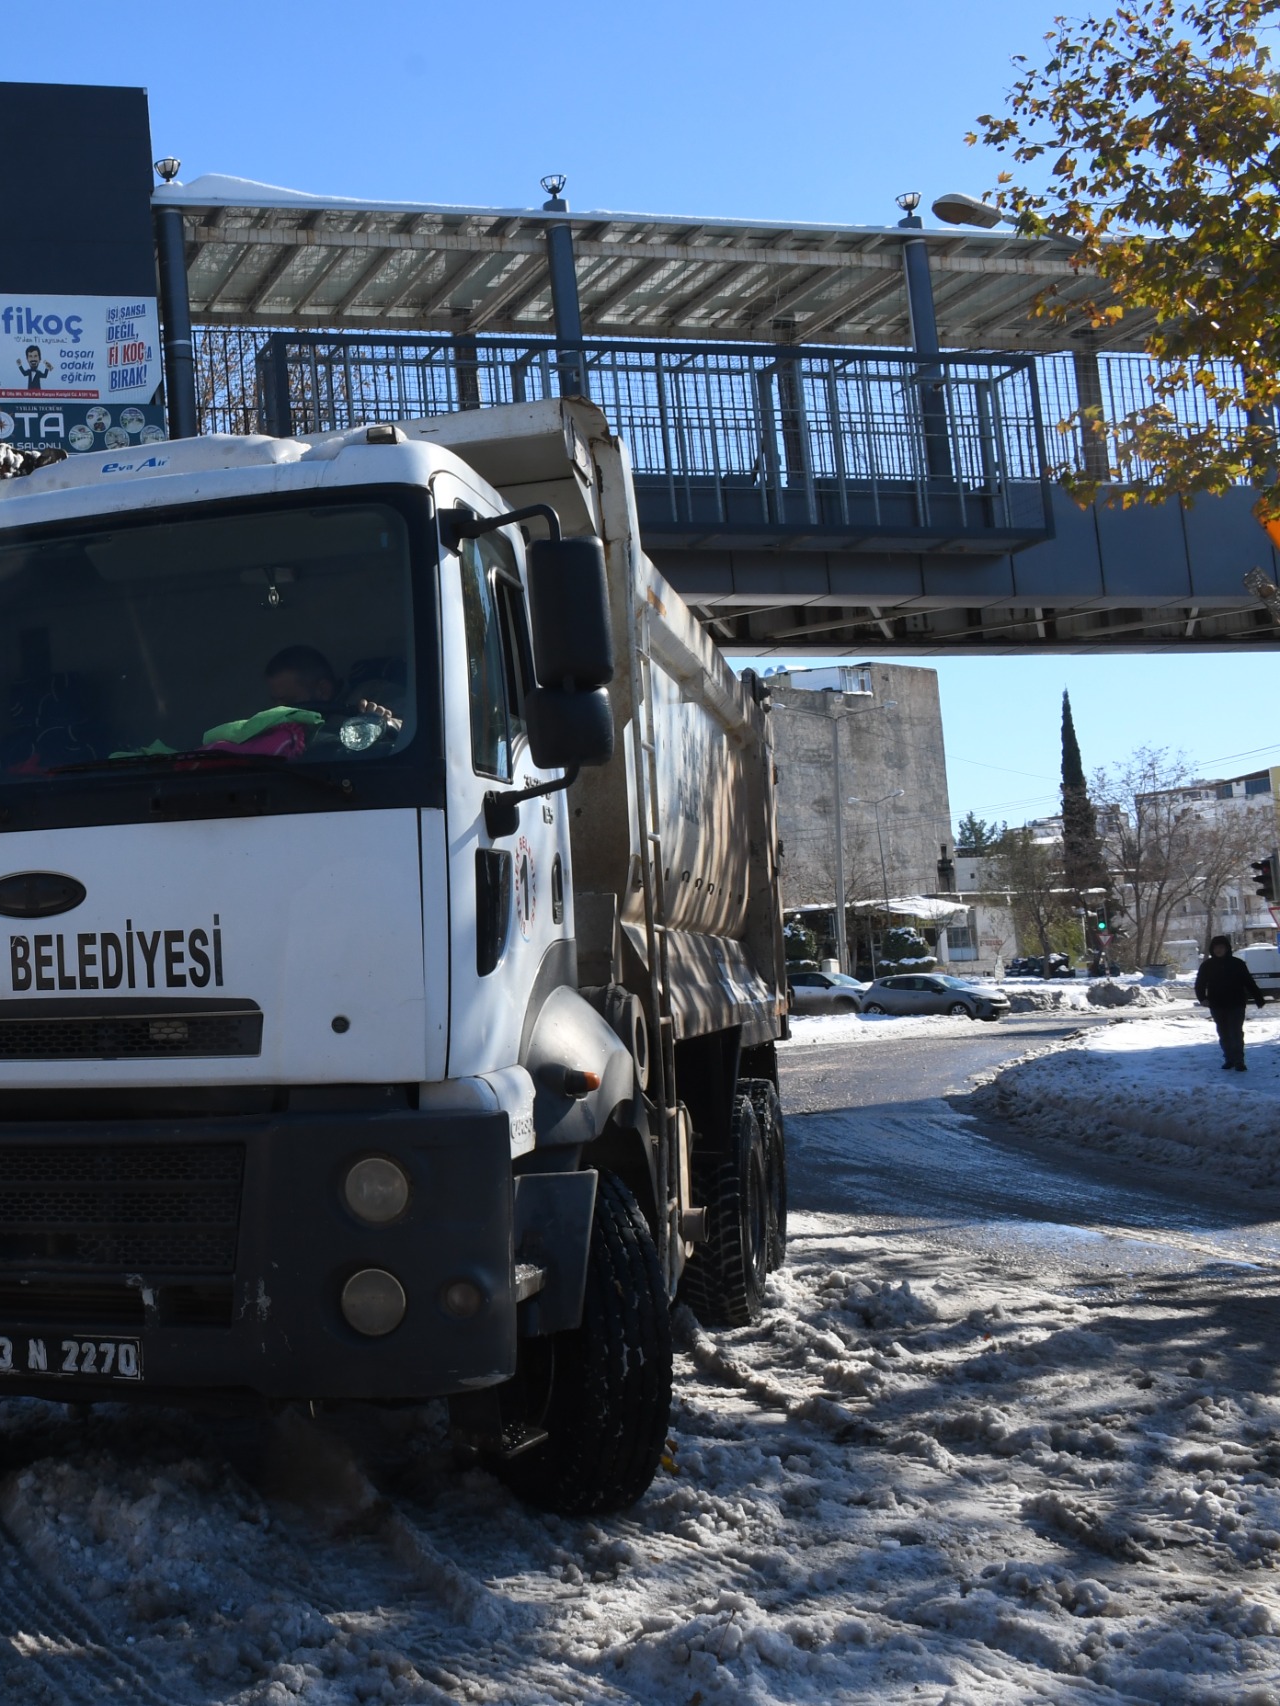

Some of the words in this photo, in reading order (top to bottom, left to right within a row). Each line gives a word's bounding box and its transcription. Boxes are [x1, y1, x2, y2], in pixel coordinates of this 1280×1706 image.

[120, 304, 146, 320] ŞANSA
[1, 306, 84, 344] fikoç
[107, 321, 139, 341] DEĞİL,
[59, 349, 95, 360] başarı
[60, 361, 95, 370] odaklı
[60, 372, 96, 384] eğitim
[110, 364, 148, 390] BIRAK!
[16, 442, 62, 450] SALONU
[520, 854, 530, 921] 1
[10, 913, 225, 993] BELEDİYESİ
[27, 1338, 48, 1371] N
[61, 1340, 138, 1377] 2270
